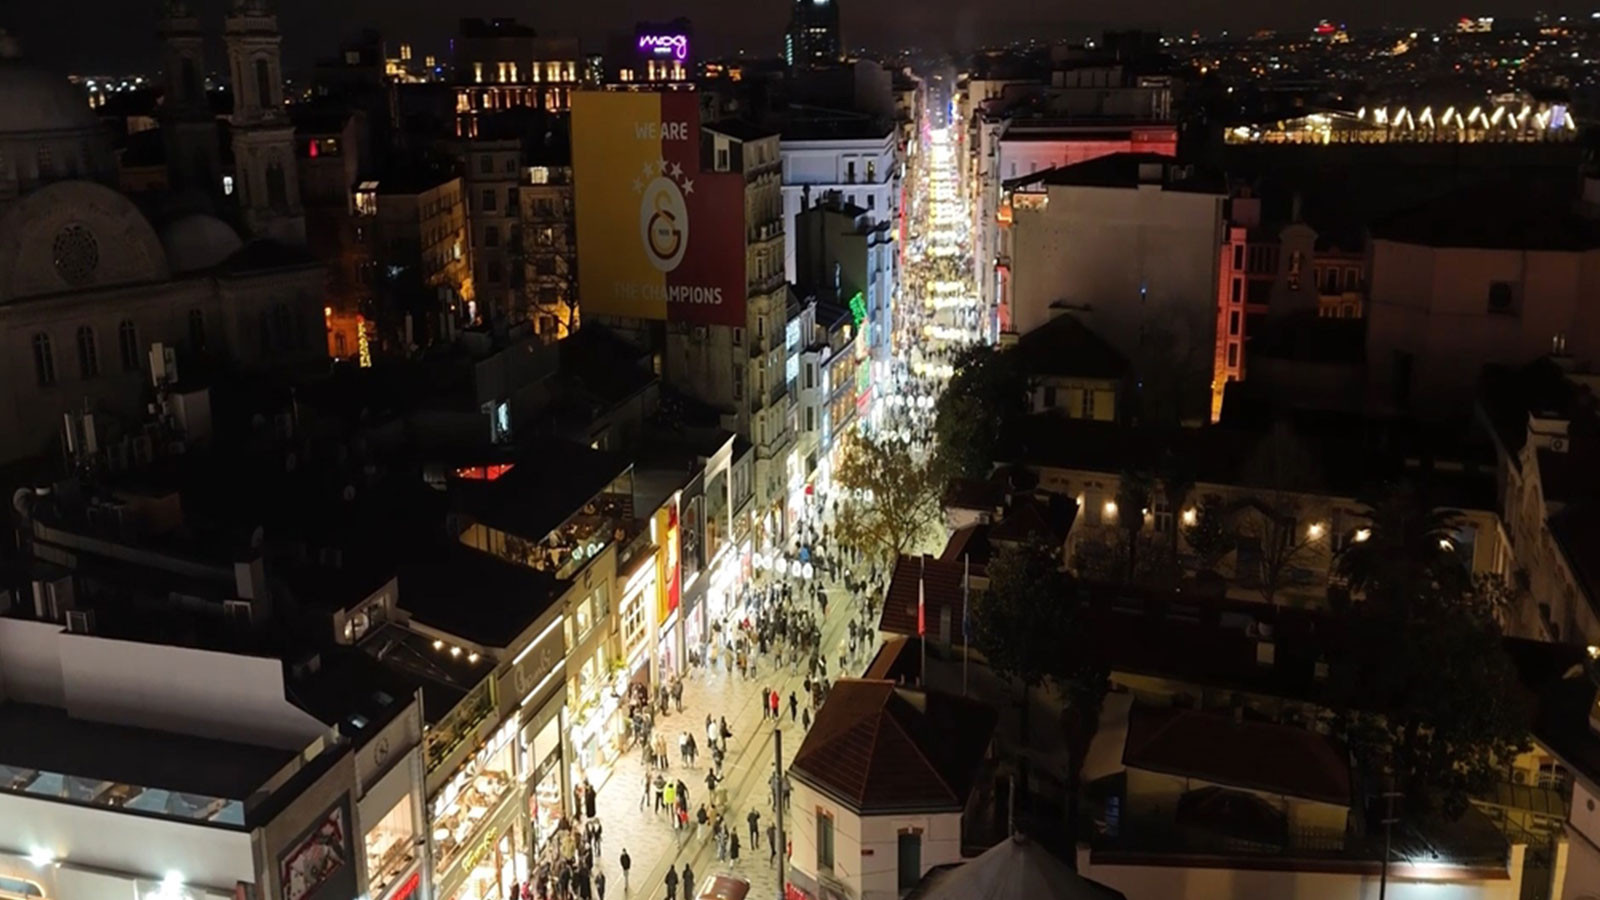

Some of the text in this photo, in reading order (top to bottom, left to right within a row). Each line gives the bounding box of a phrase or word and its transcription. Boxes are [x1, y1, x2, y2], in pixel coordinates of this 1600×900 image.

[634, 122, 688, 140] WE ARE
[614, 282, 723, 305] THE CHAMPIONS
